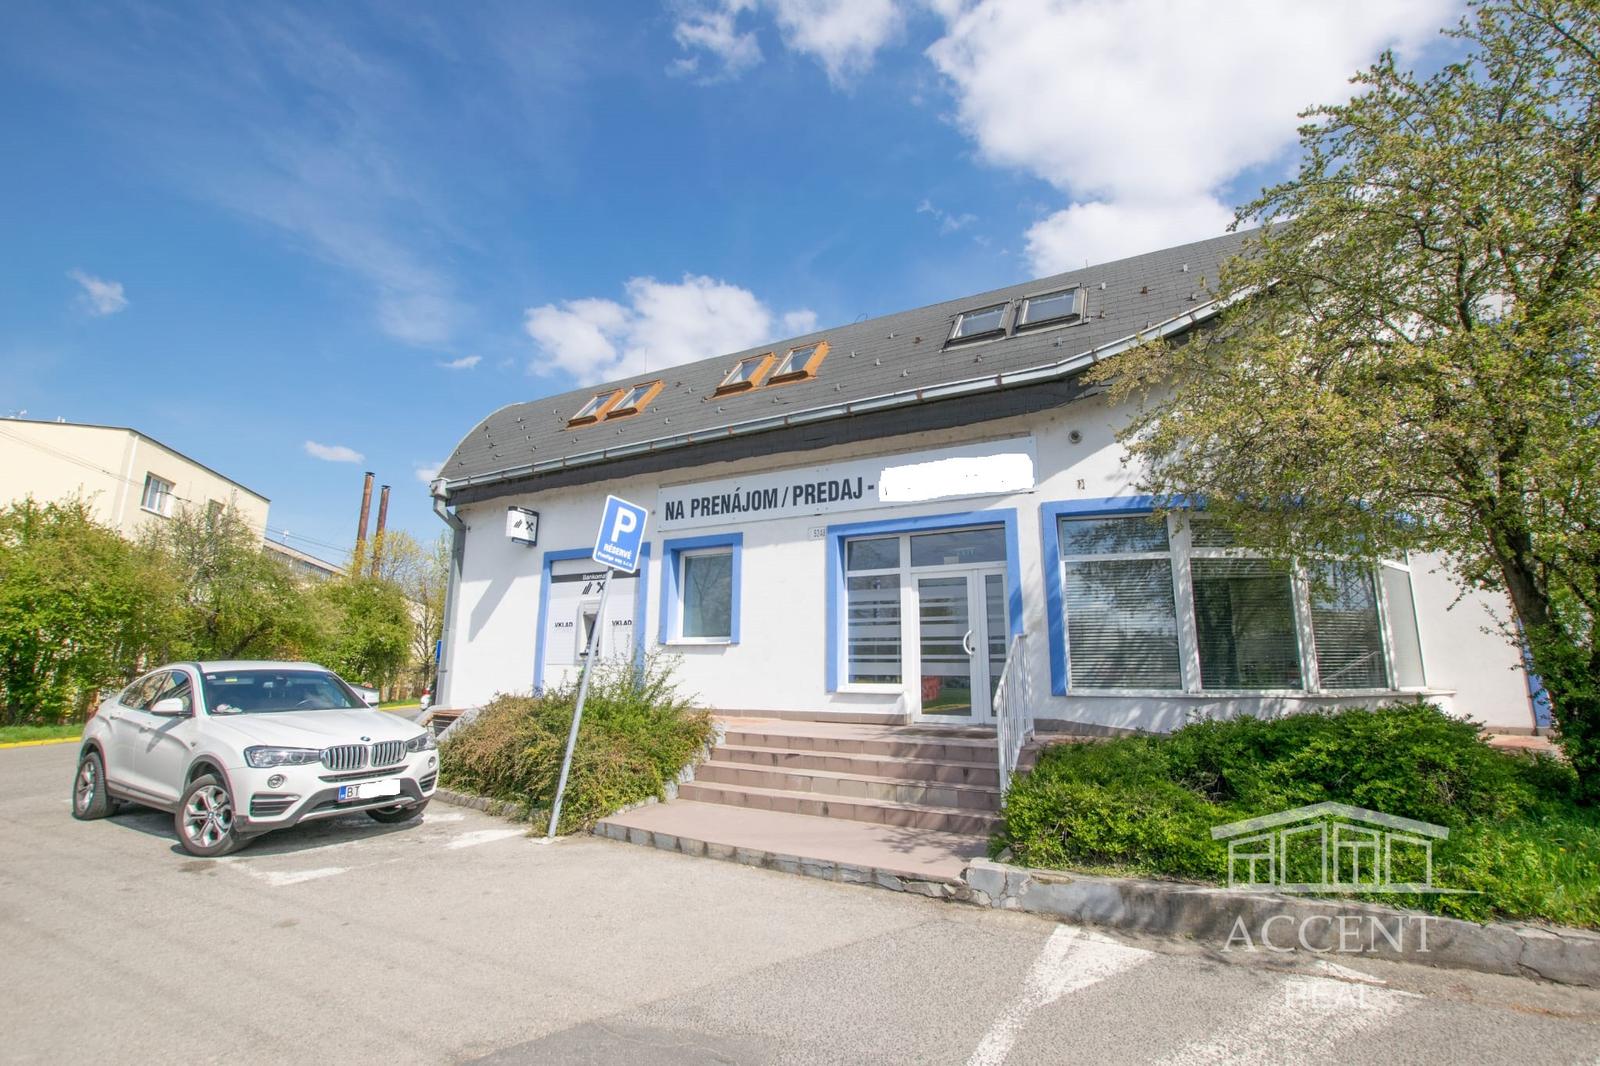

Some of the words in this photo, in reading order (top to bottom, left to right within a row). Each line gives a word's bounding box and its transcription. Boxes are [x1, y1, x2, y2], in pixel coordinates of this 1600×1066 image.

[665, 500, 685, 521] NA
[690, 487, 779, 519] PRENÁJOM
[611, 506, 637, 543] P
[582, 573, 608, 581] Bankoma
